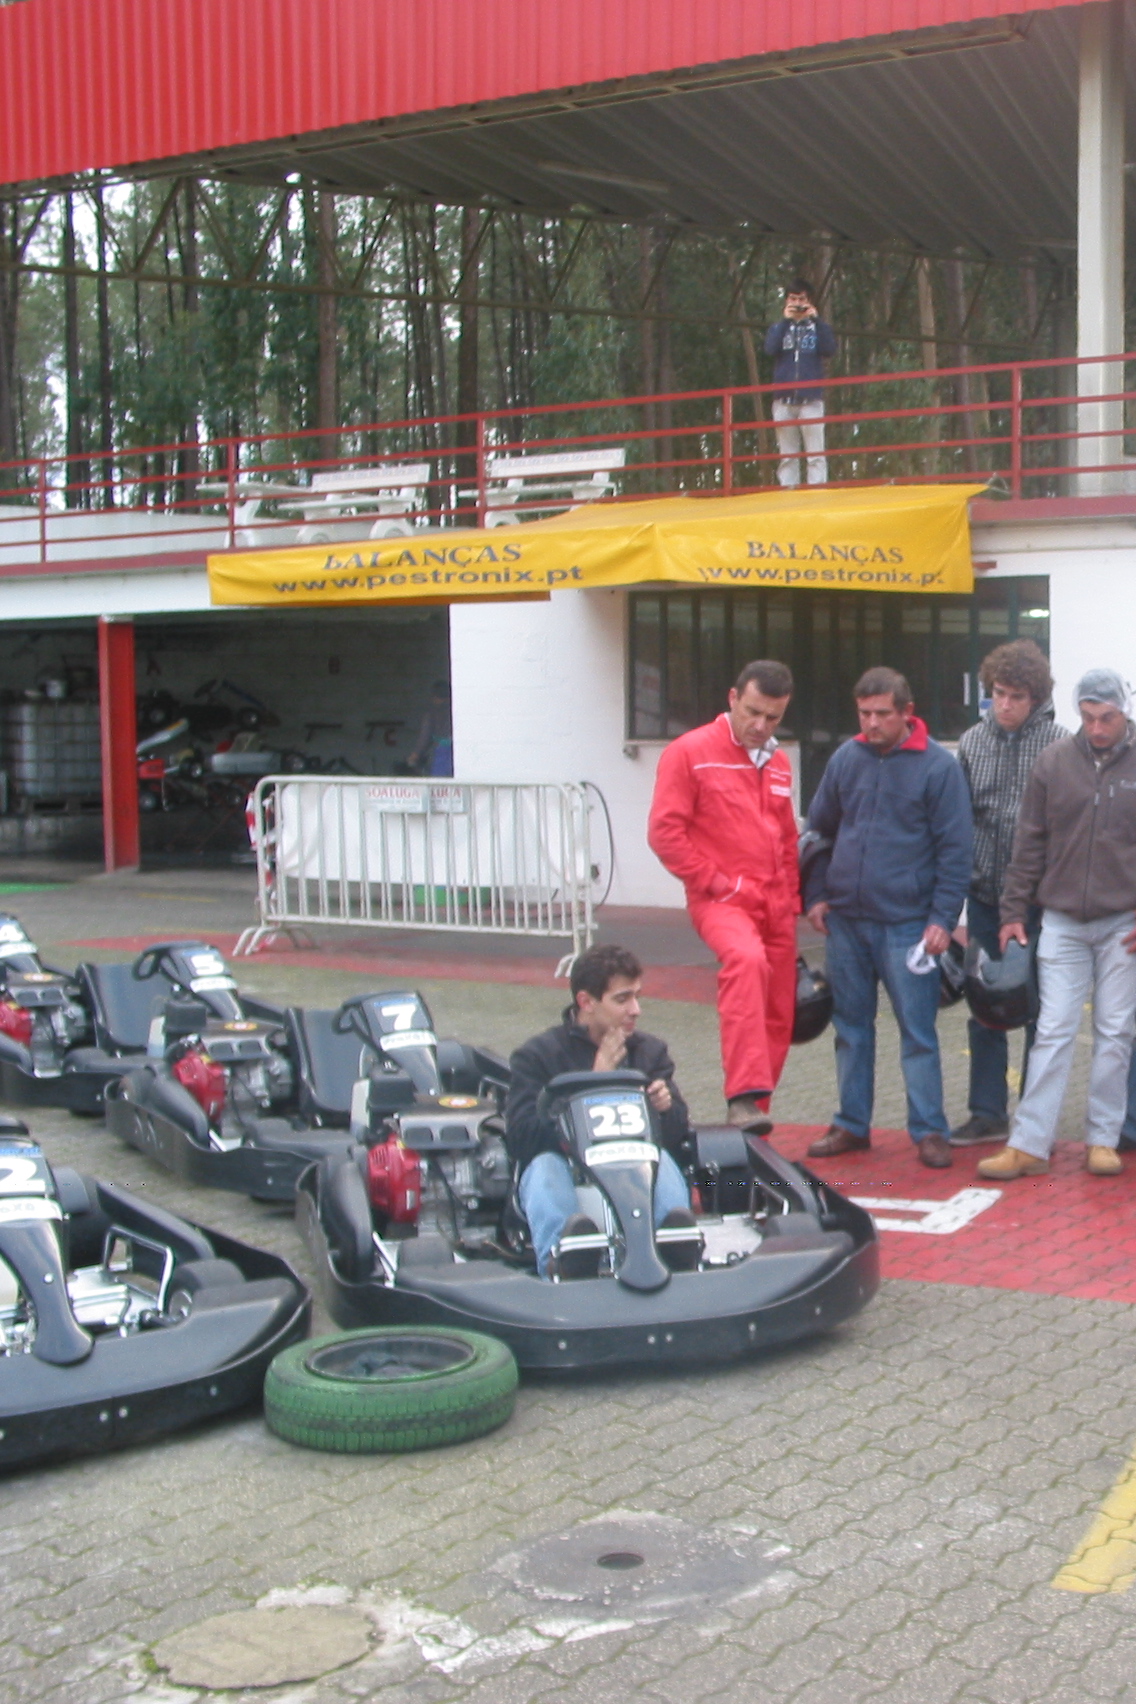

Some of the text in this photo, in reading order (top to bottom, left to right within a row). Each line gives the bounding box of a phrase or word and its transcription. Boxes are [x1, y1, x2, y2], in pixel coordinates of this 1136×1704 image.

[746, 541, 904, 567] BALANÇAS
[272, 565, 584, 593] www.pestronix.pt
[190, 954, 225, 976] 5
[381, 1003, 416, 1031] 7
[588, 1104, 646, 1137] 23
